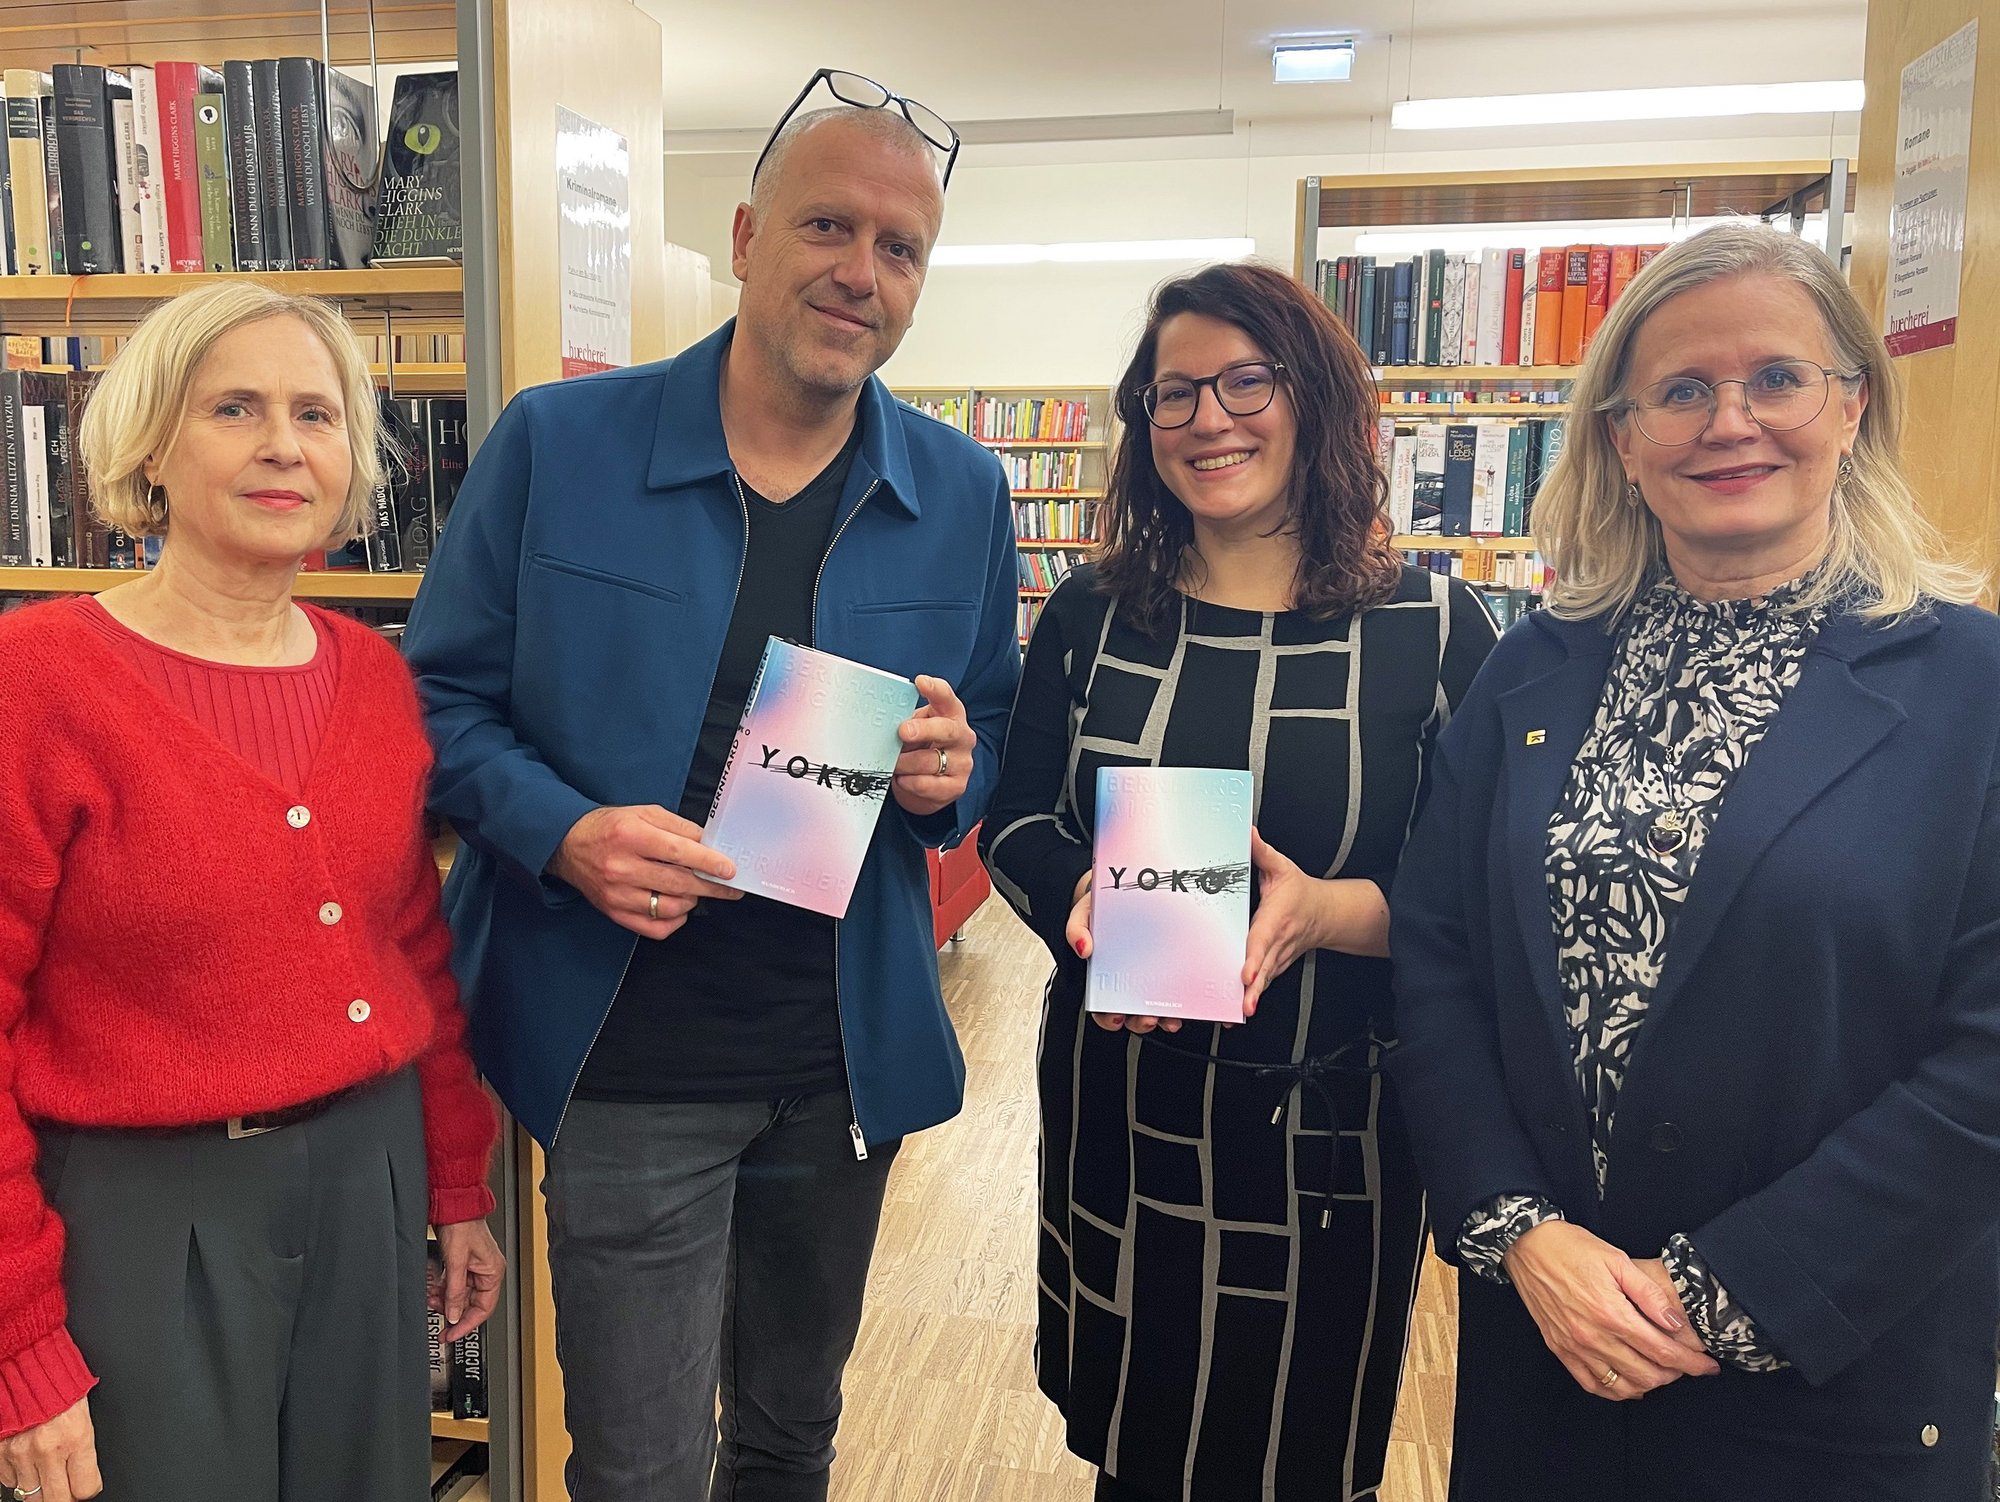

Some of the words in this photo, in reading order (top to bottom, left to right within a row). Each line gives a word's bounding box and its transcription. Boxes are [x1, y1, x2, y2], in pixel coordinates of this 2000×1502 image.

[169, 100, 178, 124] CLARK
[290, 106, 300, 137] CLARK
[300, 103, 310, 128] LEBST
[172, 126, 180, 158] HIGGINS
[244, 124, 254, 144] MIR
[302, 130, 312, 159] NOCH
[1904, 128, 1931, 152] Romane
[233, 134, 243, 166] CLARK
[264, 141, 274, 178] HIGGINS
[294, 138, 304, 177] HIGGINS
[174, 159, 182, 181] MARY
[245, 146, 256, 194] GEHÖRST
[304, 160, 312, 174] DU
[236, 170, 246, 212] HIGGINS
[277, 176, 286, 207] EINSAM
[296, 180, 306, 207] MARY
[306, 178, 315, 206] WENN
[380, 187, 443, 203] HIGGINS
[384, 174, 424, 190] MARY
[566, 177, 617, 208] Kriminalromane
[248, 196, 257, 212] DU
[378, 202, 424, 217] CLARK
[238, 214, 248, 244] MARY
[250, 214, 260, 244] DENN
[374, 230, 397, 244] DIE
[402, 226, 461, 243] DUNKLE
[376, 216, 416, 231] FLIEH
[420, 214, 437, 228] IN
[373, 242, 422, 257] NACHT
[1890, 304, 1930, 334] buecherei
[4, 395, 15, 440] ATEMZUG
[7, 442, 17, 482] LETZTEN
[50, 440, 60, 456] ICH
[1448, 449, 1474, 458] LEBEN
[442, 458, 464, 469] Eine
[9, 484, 19, 520] DEINEM
[11, 524, 20, 541] MIT
[380, 510, 389, 528] DAS
[410, 496, 429, 564] HOAG
[709, 738, 740, 820] BERNHARD
[743, 651, 769, 719] AICHNER
[762, 744, 867, 796] YOKO
[1108, 866, 1228, 895] YOKO
